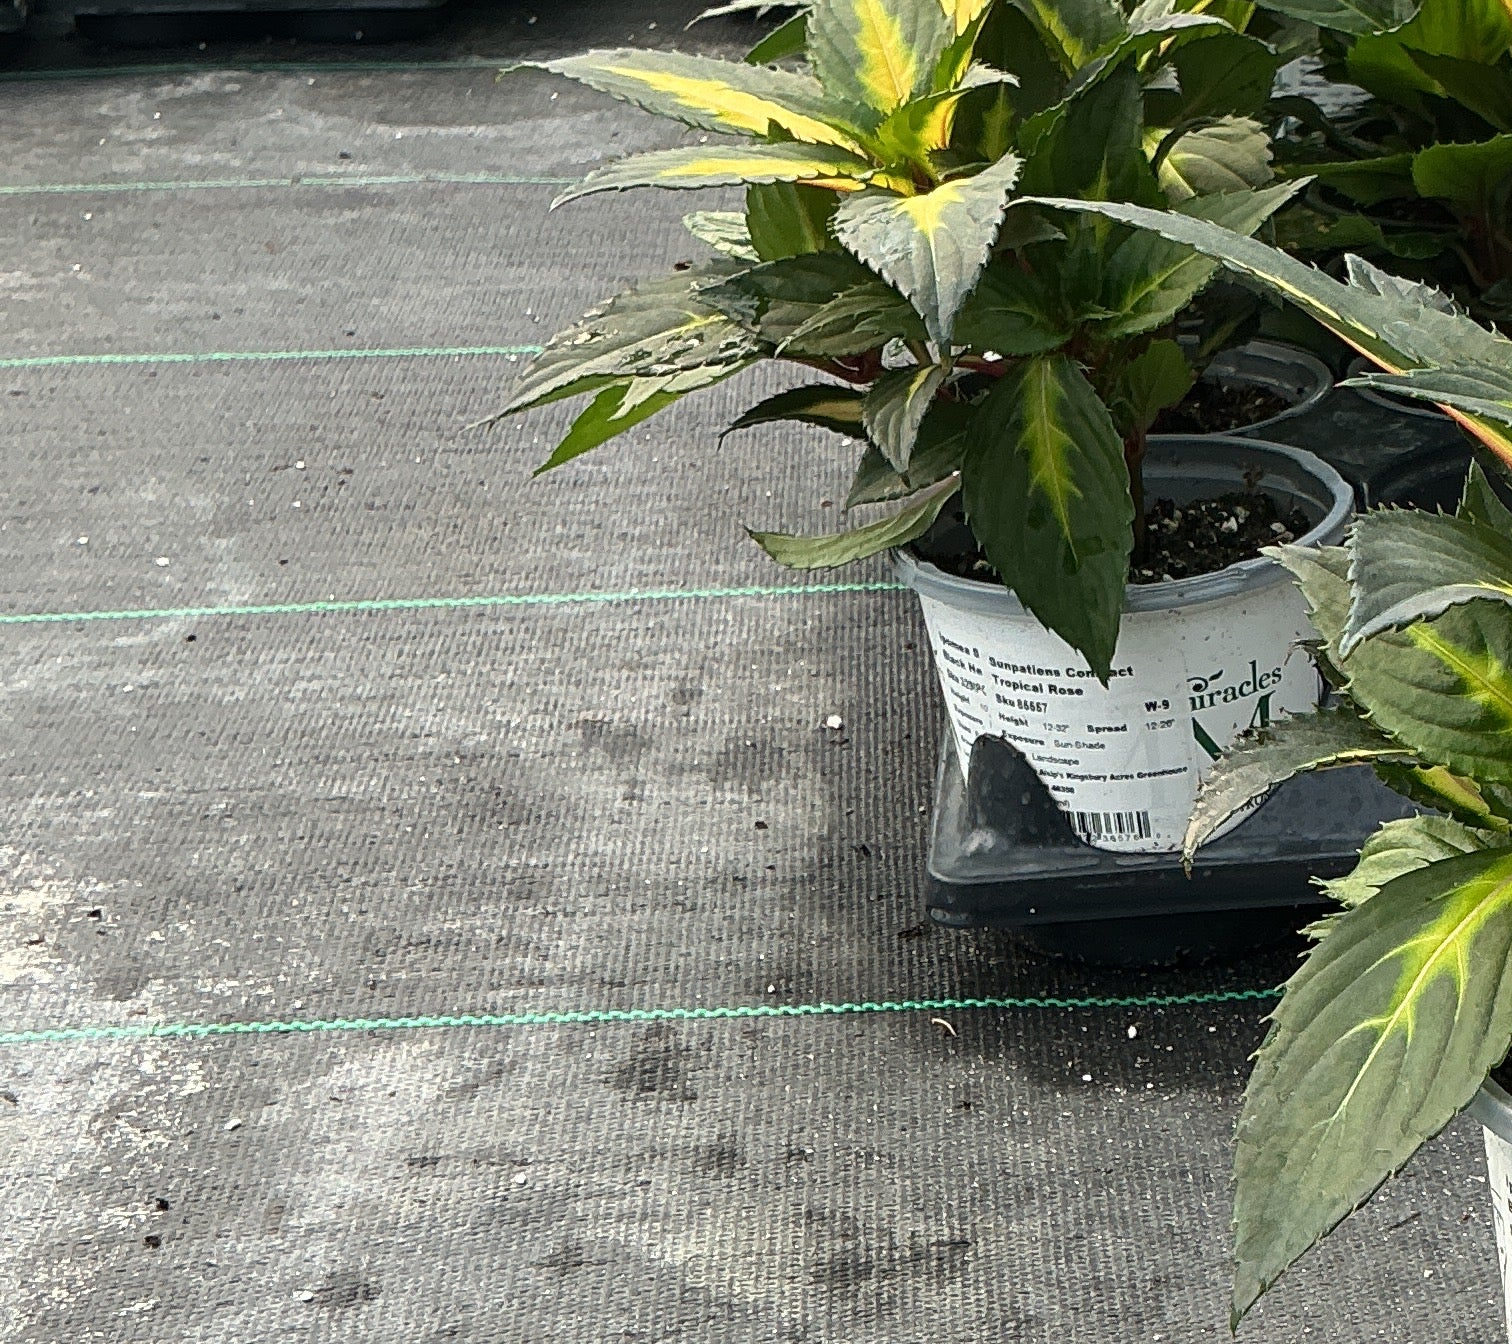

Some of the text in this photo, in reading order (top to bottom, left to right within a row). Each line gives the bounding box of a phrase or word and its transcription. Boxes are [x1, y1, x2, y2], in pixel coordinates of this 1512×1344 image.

[988, 656, 1134, 679] Sunpatiens Comact
[991, 673, 1044, 694] Tropical
[1048, 684, 1084, 696] Rose
[995, 693, 1016, 707] Sku
[1144, 699, 1170, 713] W-9
[1086, 723, 1128, 734] Spread
